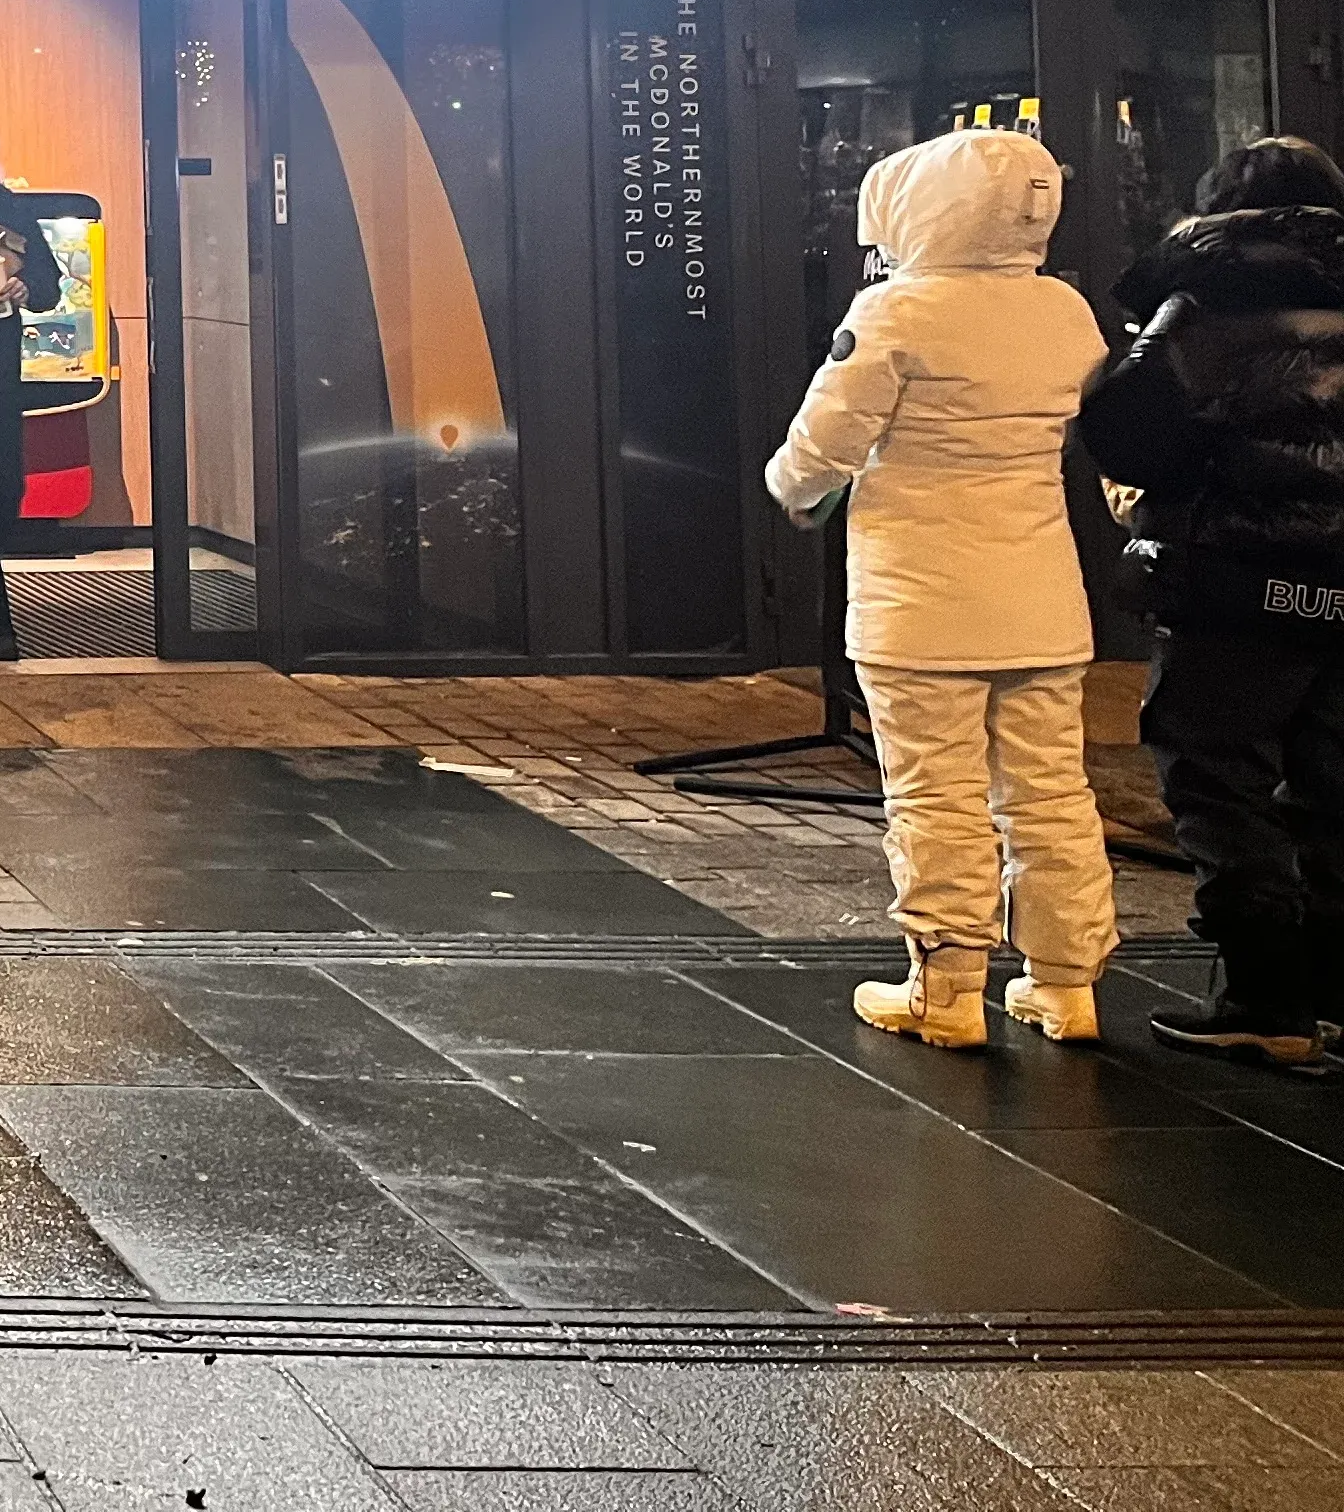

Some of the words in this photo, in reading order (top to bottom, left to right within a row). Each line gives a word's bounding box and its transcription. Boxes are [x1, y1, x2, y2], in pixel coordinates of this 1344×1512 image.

[619, 31, 640, 62] IN
[620, 78, 641, 137] THE
[648, 35, 675, 249] MCDONALD'S
[622, 154, 645, 267] WORLD
[678, 54, 707, 321] NORTHERNMOST
